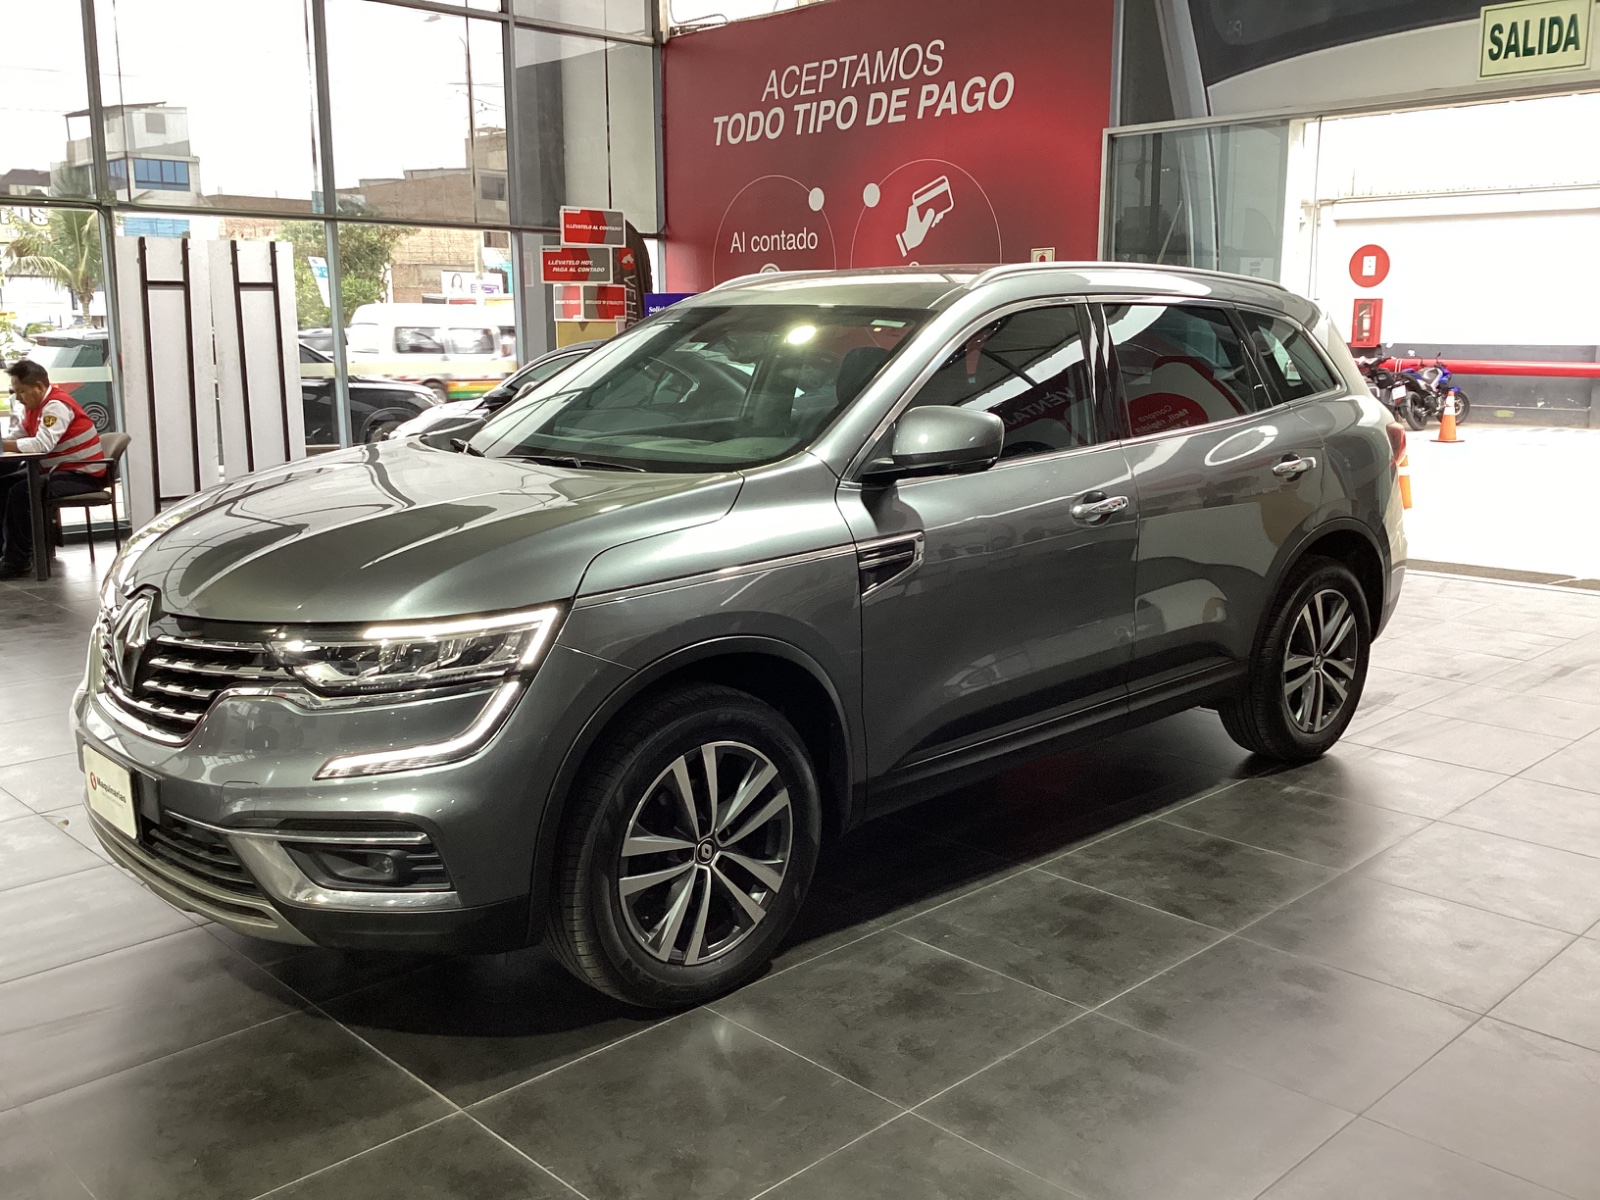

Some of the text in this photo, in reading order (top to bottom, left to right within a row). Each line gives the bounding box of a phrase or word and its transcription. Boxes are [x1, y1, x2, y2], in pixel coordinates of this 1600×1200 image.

[1488, 13, 1580, 61] SALIDA
[761, 39, 945, 102] ACEPTAMOS
[713, 71, 1015, 146] TODO TIPO DE PAGO
[730, 227, 818, 253] Al contado
